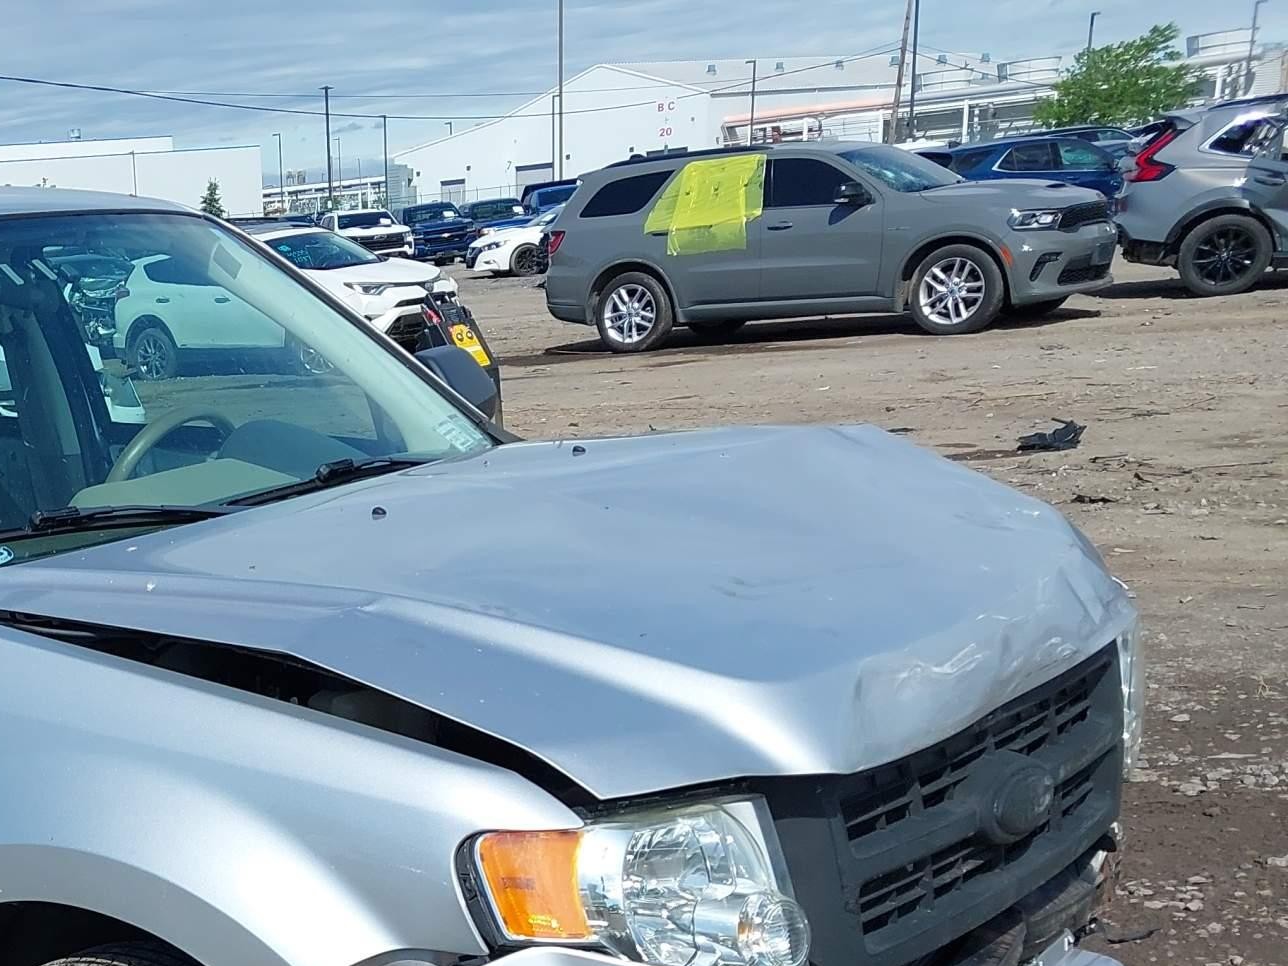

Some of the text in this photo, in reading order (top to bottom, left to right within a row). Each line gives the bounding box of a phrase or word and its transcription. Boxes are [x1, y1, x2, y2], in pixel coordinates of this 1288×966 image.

[657, 101, 675, 112] B C
[659, 127, 673, 137] 20
